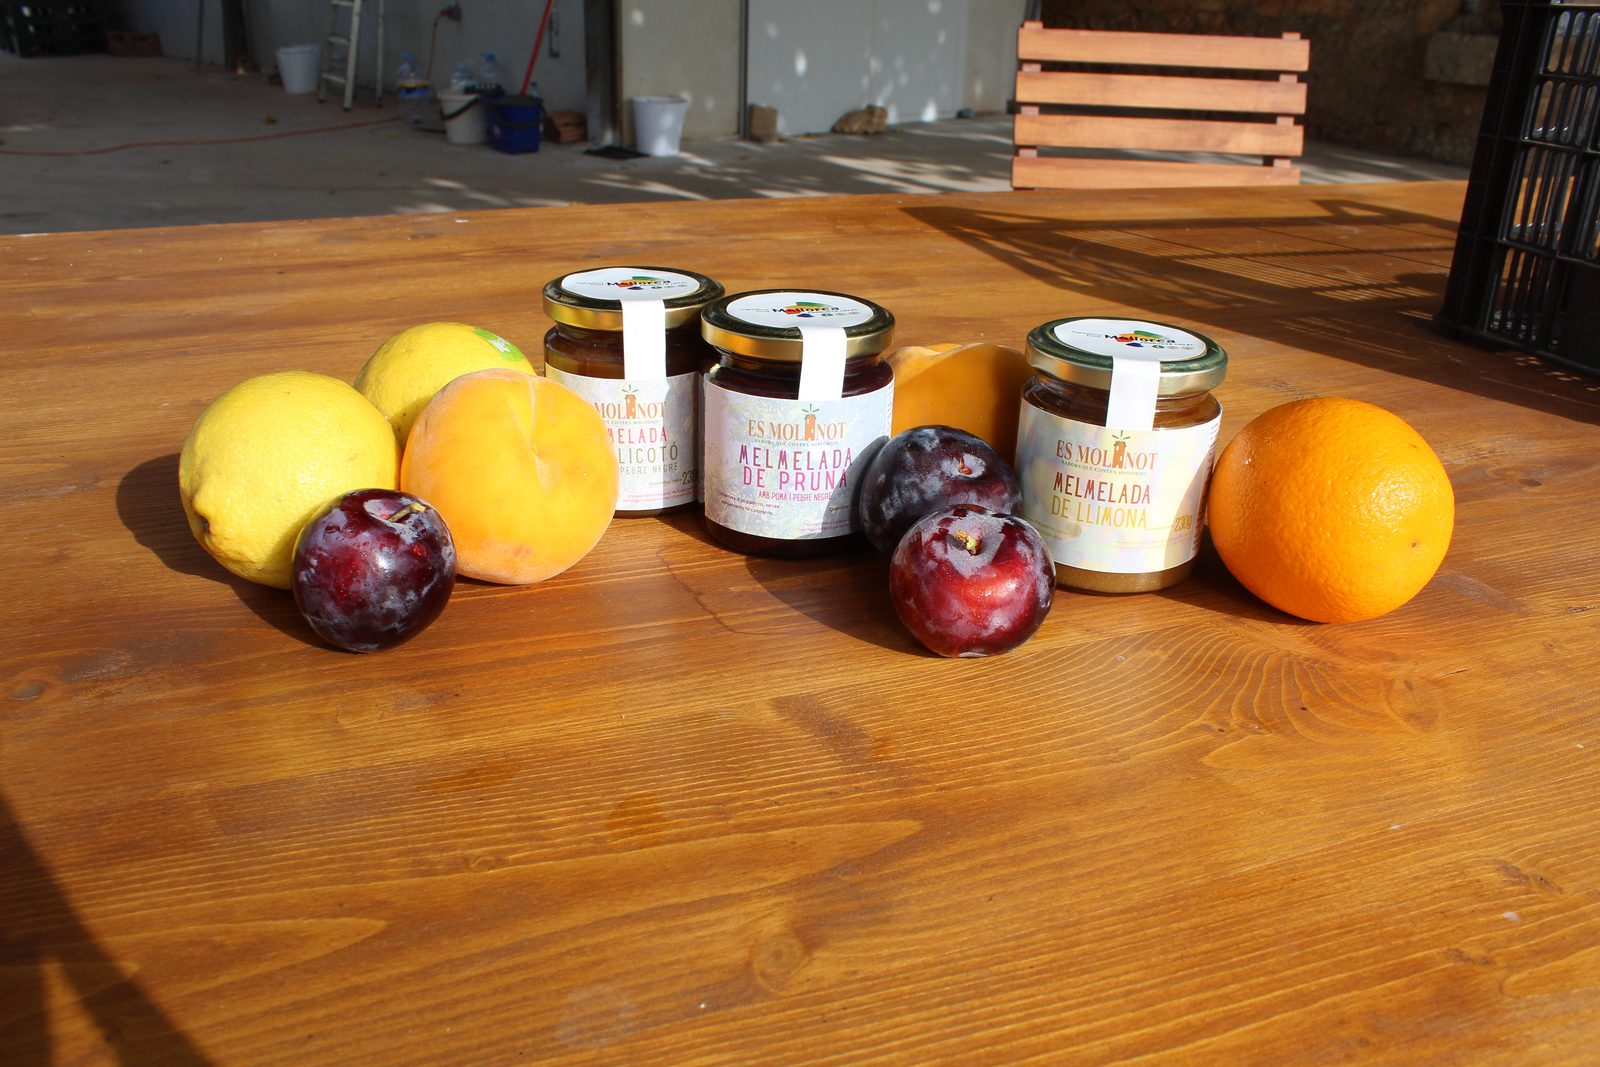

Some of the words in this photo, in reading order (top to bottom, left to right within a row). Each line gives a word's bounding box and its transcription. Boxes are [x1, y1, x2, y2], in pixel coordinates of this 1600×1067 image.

[748, 419, 765, 438] ES
[739, 444, 852, 471] MELMELADA
[1056, 440, 1073, 460] ES
[620, 465, 647, 475] PEBRE
[652, 462, 678, 473] NEGRE
[743, 466, 766, 488] DE
[779, 468, 848, 492] PRUNA
[772, 492, 788, 501] POMA
[793, 493, 812, 502] PEBRE
[814, 491, 832, 501] NEGRE
[1053, 472, 1150, 505] MELMELADA
[1051, 495, 1071, 519] DE
[1076, 502, 1148, 529] LLIMONA
